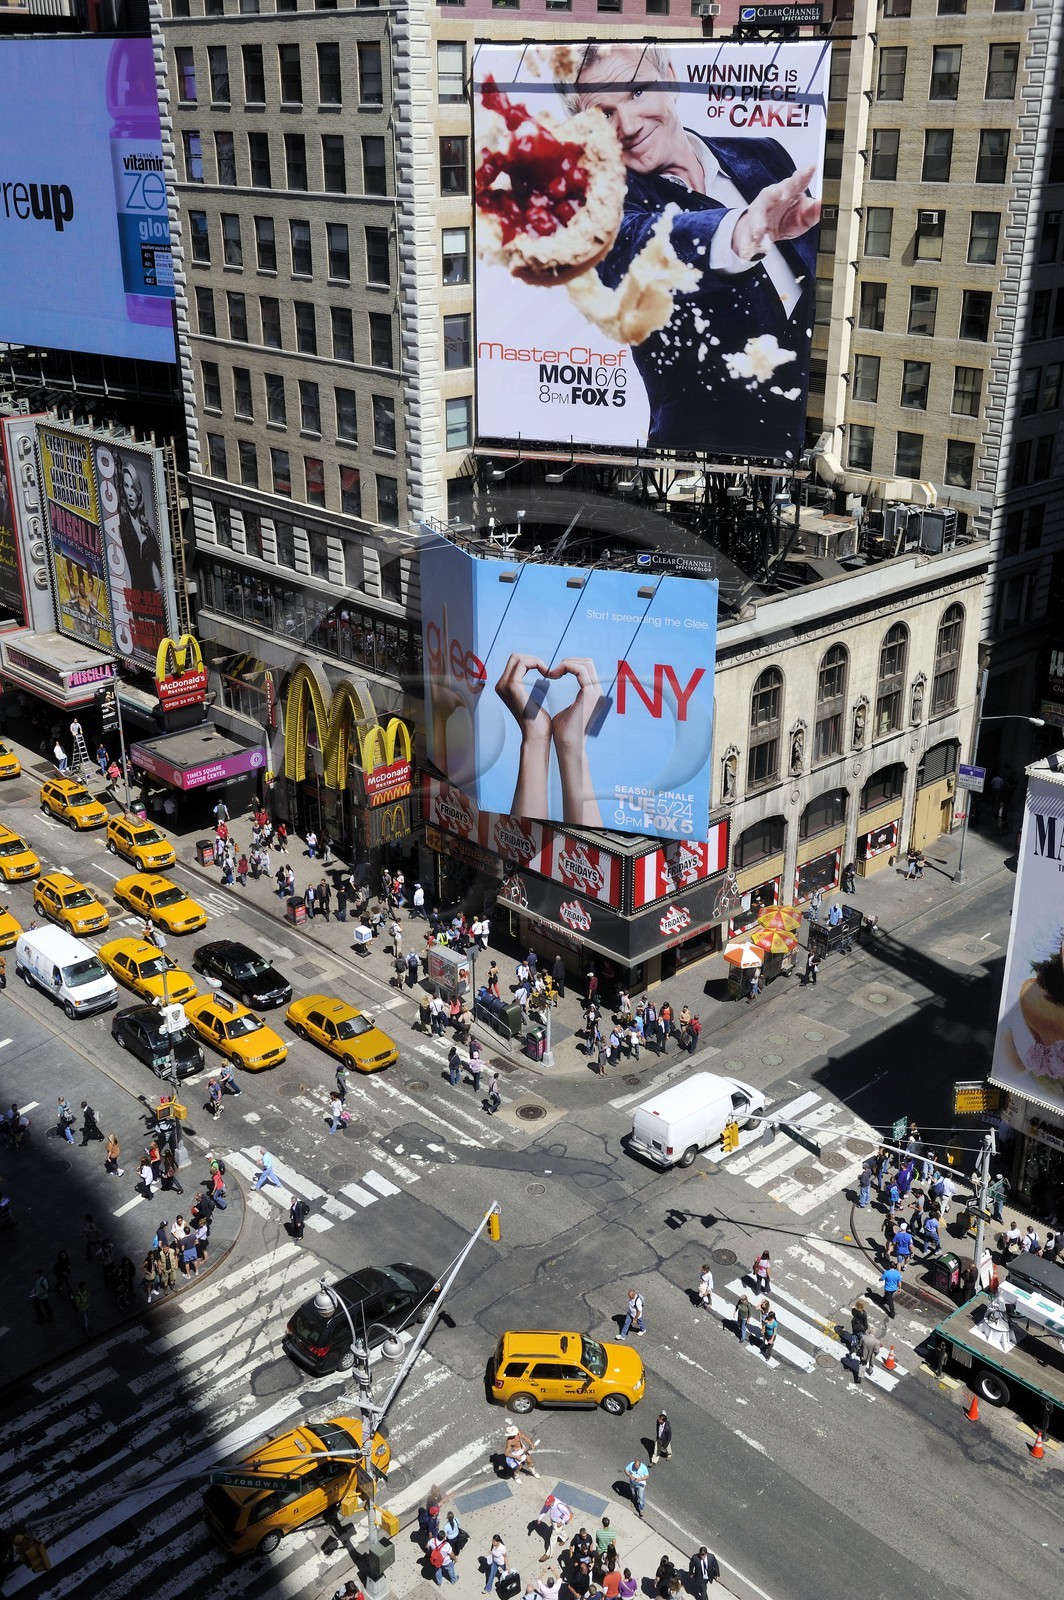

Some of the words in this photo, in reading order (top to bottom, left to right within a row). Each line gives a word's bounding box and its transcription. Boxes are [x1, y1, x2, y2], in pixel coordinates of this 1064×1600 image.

[687, 64, 779, 83] WINNING
[785, 69, 798, 82] IS
[708, 85, 736, 102] NO
[741, 85, 797, 101] PIECE
[707, 106, 725, 118] OF
[729, 104, 810, 127] CAKE!
[0, 182, 74, 232] reup
[478, 342, 627, 367] MasterChef
[539, 364, 592, 386] MON
[595, 367, 627, 388] 6/6
[538, 385, 570, 404] 8PM
[571, 386, 609, 407] FOX
[612, 390, 626, 407] 5
[44, 433, 88, 460] EVERYTHING
[51, 452, 64, 471] YOU
[65, 455, 83, 476] EVER
[50, 467, 77, 490] WANTED
[78, 475, 89, 495] ON
[52, 484, 91, 510] BROADWAY!
[17, 435, 49, 590] PALACE
[50, 502, 101, 556] PRISCILLA
[85, 549, 101, 562] DESER
[97, 446, 134, 655] CHICAGO
[586, 609, 609, 620] Start
[611, 612, 662, 628] spreading
[664, 617, 681, 627] the
[683, 619, 710, 630] Glee.
[68, 665, 113, 688] PRISCILLA
[160, 675, 205, 691] McDonald's
[167, 684, 198, 694] Restaurant
[617, 660, 706, 721] NY
[186, 771, 202, 780] TIMES
[202, 765, 222, 776] SQUARE
[187, 775, 206, 786] VISITOR
[207, 770, 226, 780] CENTER
[375, 774, 407, 789] Restaurant
[615, 785, 655, 796] SEASON
[658, 790, 694, 802] FINALE
[615, 793, 656, 814] TUE
[656, 799, 694, 819] 5/24
[614, 809, 642, 828] 9PM
[643, 812, 678, 833] FOX
[680, 819, 694, 834] 5
[225, 1476, 287, 1490] Broadway
